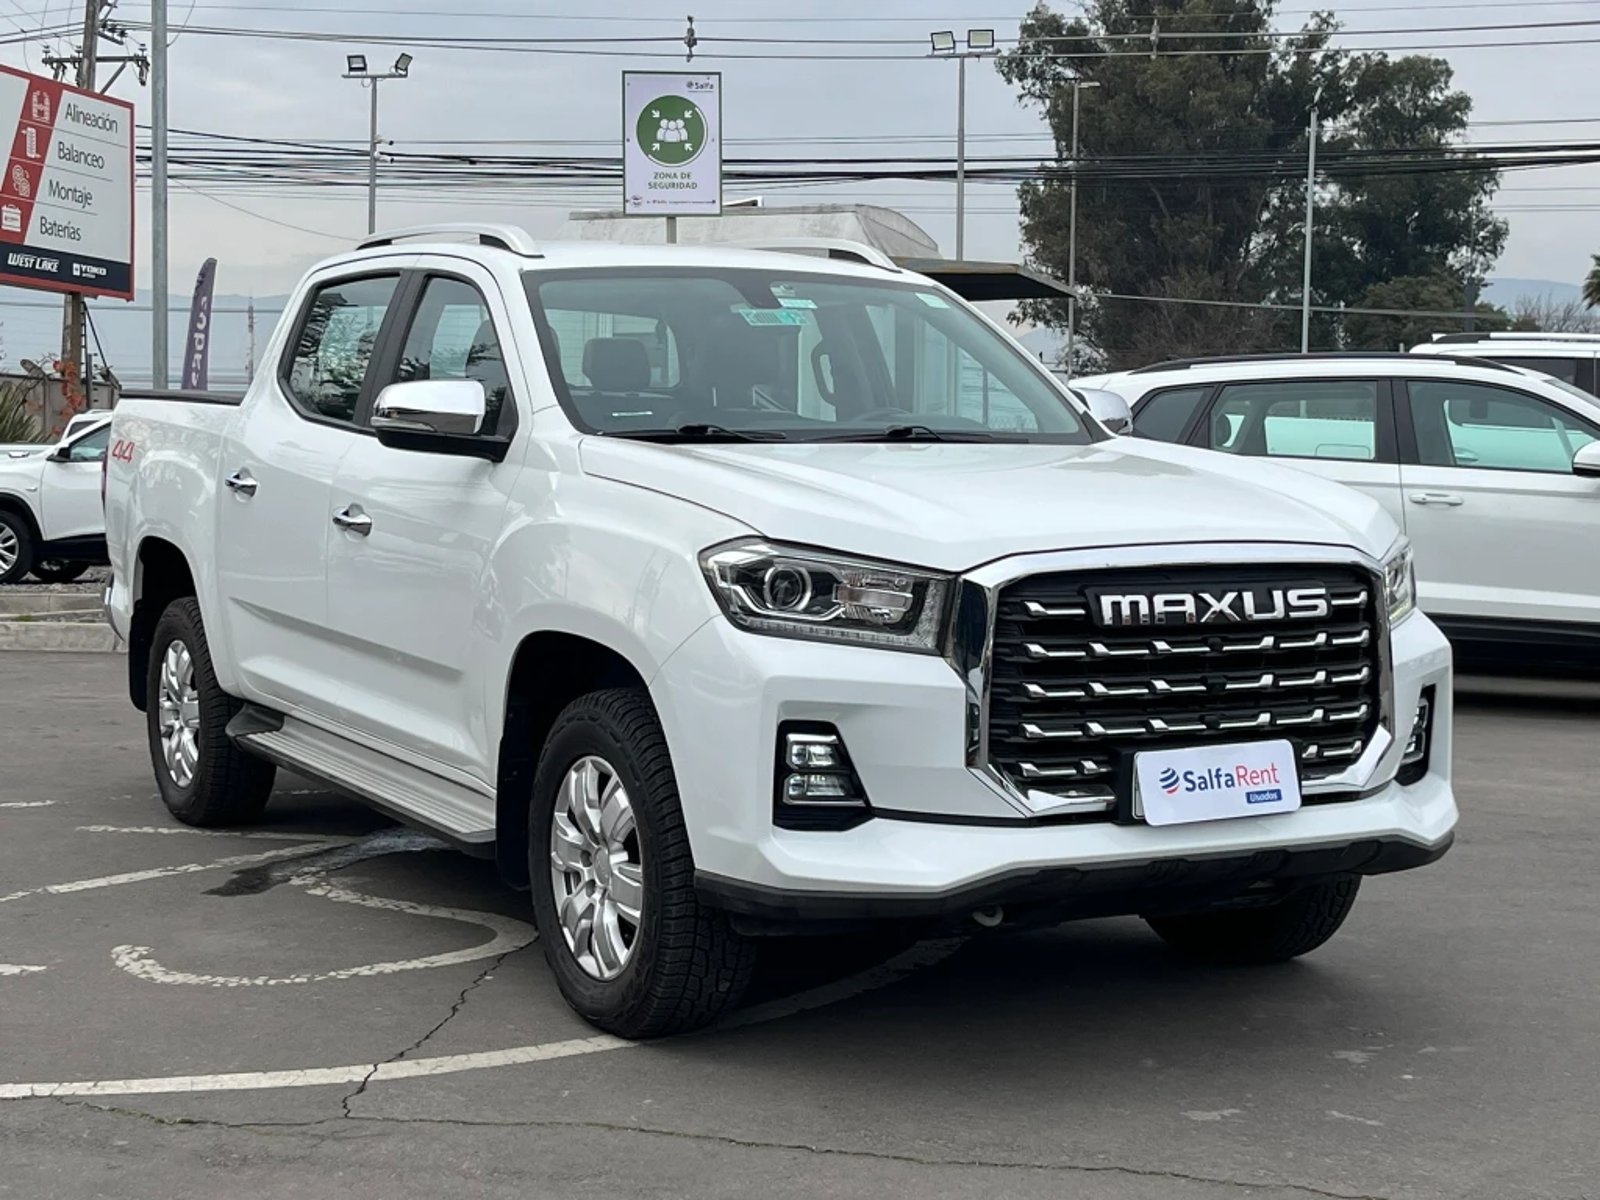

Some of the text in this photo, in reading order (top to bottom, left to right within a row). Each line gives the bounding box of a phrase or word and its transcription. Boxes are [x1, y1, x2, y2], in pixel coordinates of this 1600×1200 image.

[65, 102, 118, 134] Alineación
[57, 141, 105, 170] Balanceo
[647, 181, 698, 190] SEGURIDAD
[653, 172, 692, 180] ZONA DE
[48, 179, 93, 209] Montaje
[39, 216, 82, 242] Baterías
[7, 252, 60, 273] WEST LAKE
[1100, 588, 1328, 625] MAXUS
[1183, 762, 1281, 793] SalfaRent
[1248, 790, 1279, 803] Usados
